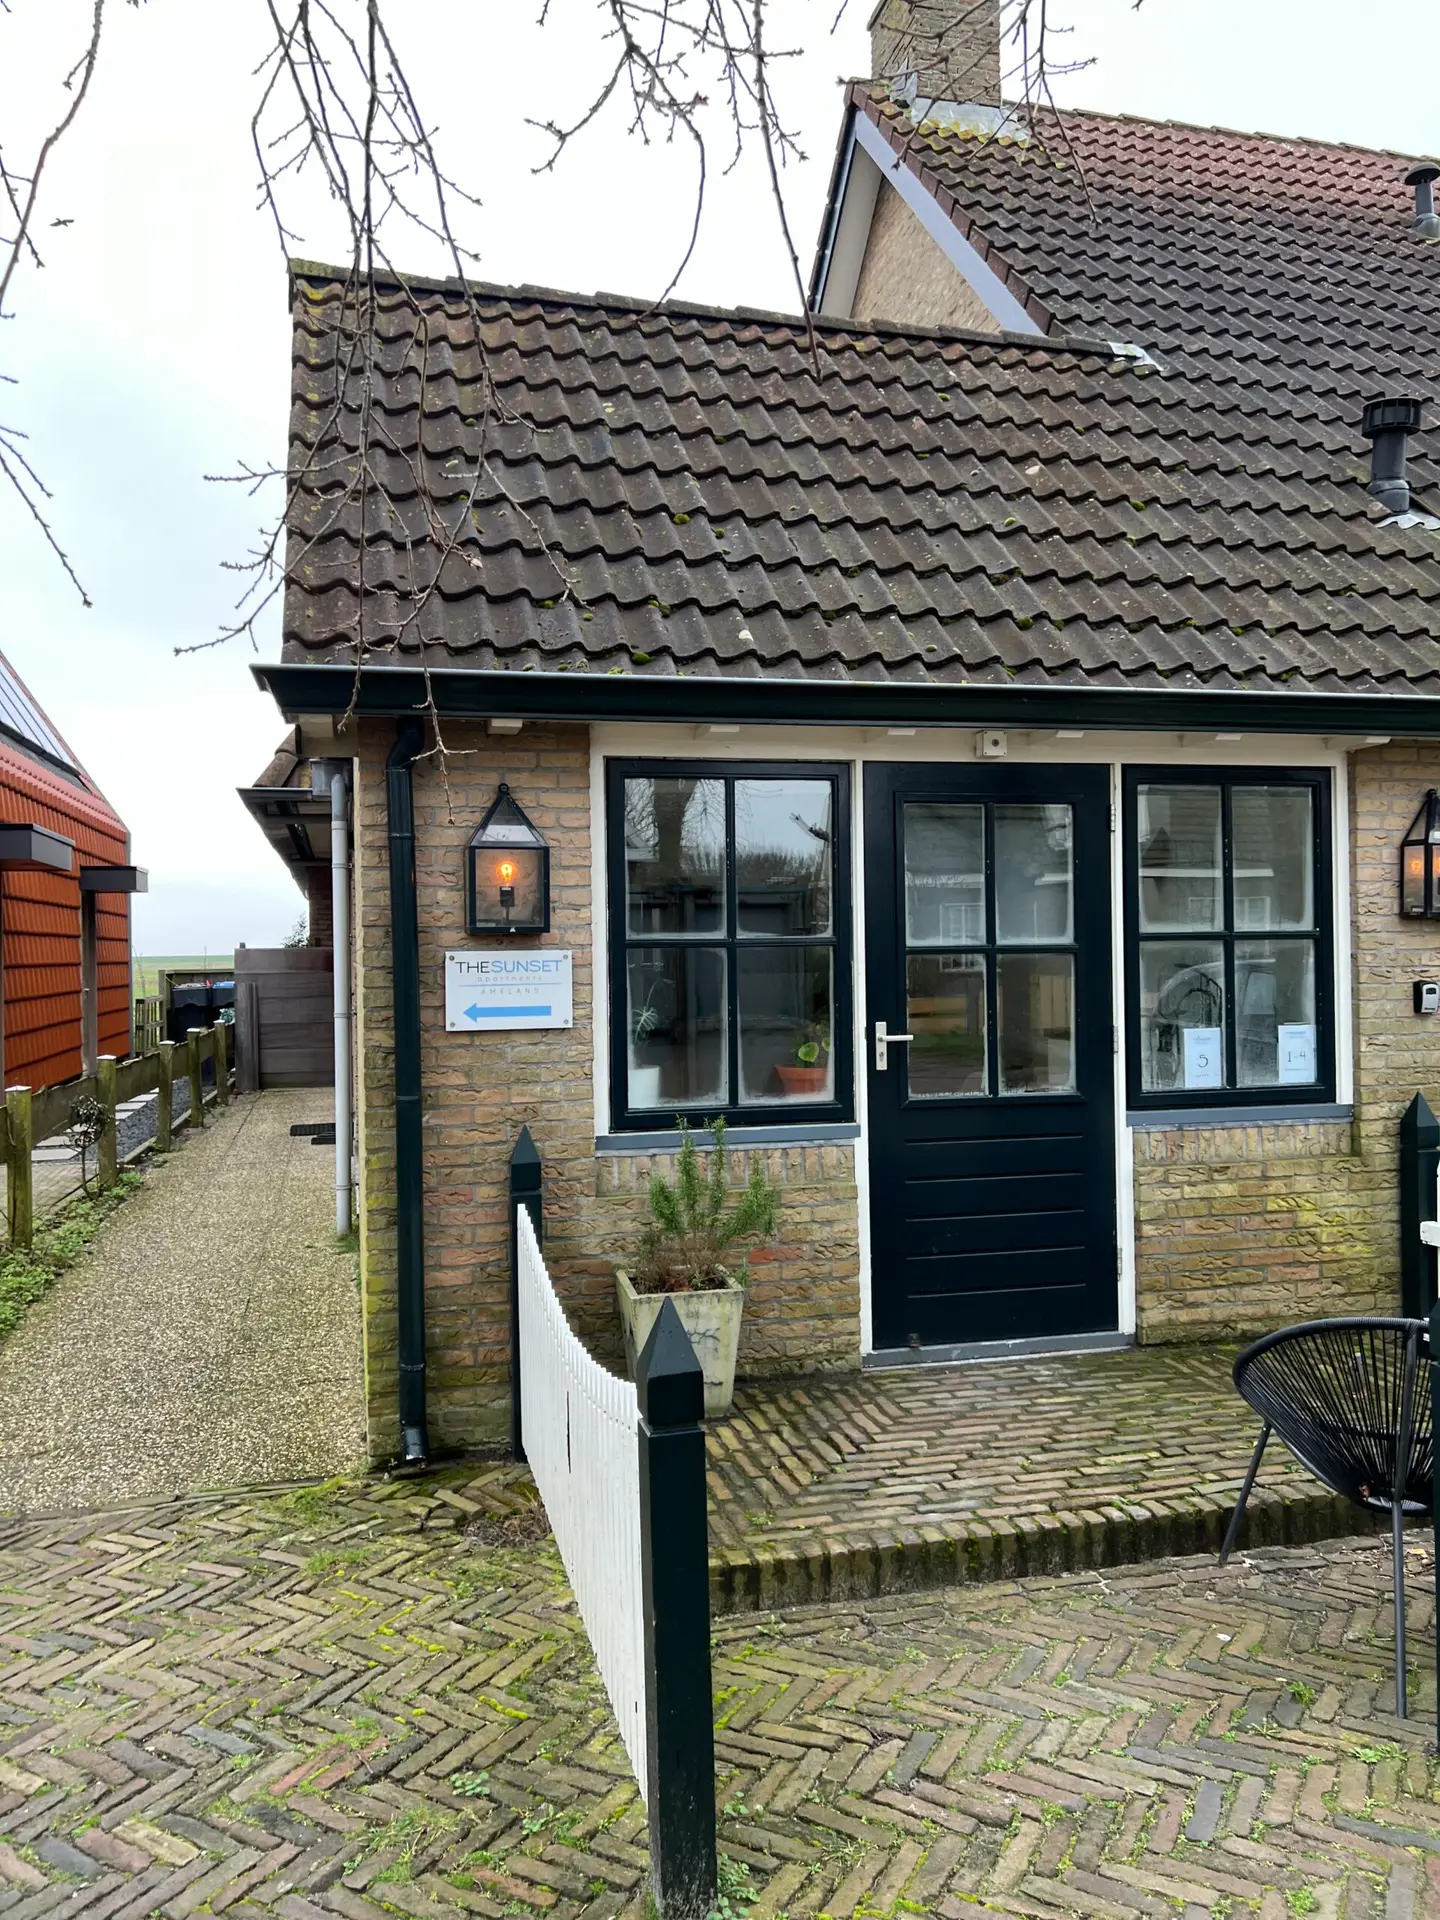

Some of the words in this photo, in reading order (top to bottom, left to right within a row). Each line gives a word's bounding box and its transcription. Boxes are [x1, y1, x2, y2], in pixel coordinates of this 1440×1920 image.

[477, 975, 542, 983] apartments
[481, 987, 540, 995] AMELAND
[1198, 1054, 1209, 1068] 5
